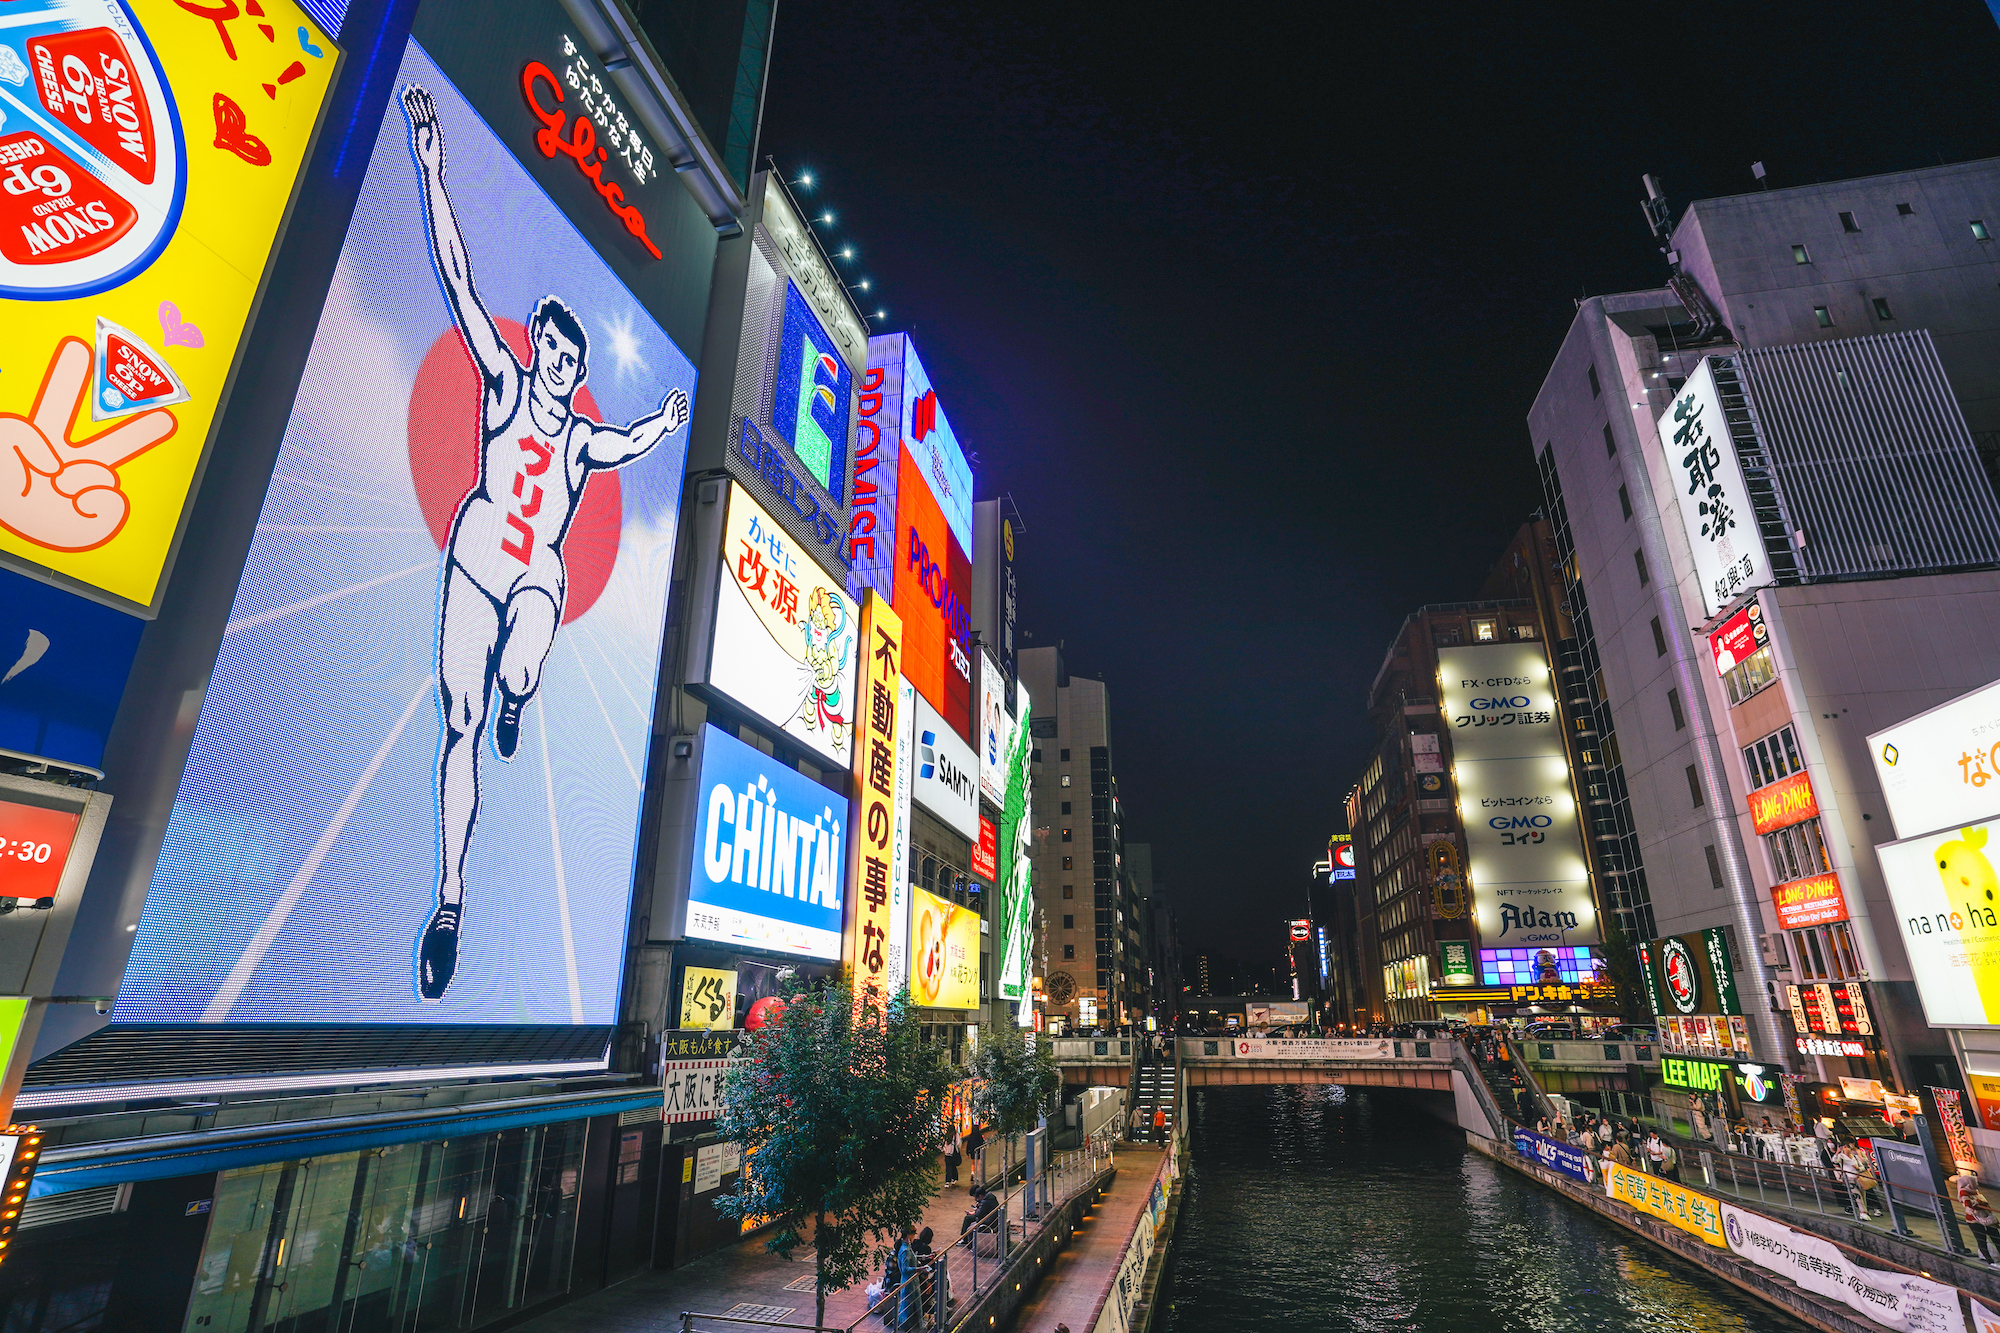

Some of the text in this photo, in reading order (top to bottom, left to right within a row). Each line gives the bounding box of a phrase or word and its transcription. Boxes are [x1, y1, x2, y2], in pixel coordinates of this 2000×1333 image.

[34, 44, 65, 114] CHEESE
[62, 54, 93, 125] 6P
[93, 76, 113, 123] BRAND
[99, 52, 148, 163] SNOW
[563, 34, 657, 178] すこやかな毎日、
[566, 65, 646, 185] ゆたかな人生
[2, 164, 72, 197] 6P
[522, 61, 663, 260] Glico
[32, 195, 76, 217] BRAND
[21, 200, 115, 256] SNOW
[108, 373, 137, 400] CHEESE
[114, 363, 145, 393] 6P
[117, 345, 166, 386] SNOW
[126, 362, 147, 382] BRAND
[850, 367, 884, 559] PROMISE
[501, 434, 555, 567] グリコ
[749, 516, 797, 579] かぜに
[737, 538, 800, 627] 改源
[909, 525, 972, 656] PROMISE
[1714, 553, 1753, 602] 紹興酒
[947, 638, 971, 684] プロミス
[1455, 711, 1551, 728] クリック証券
[1470, 696, 1531, 710] GMO
[939, 753, 975, 807] SAMTY
[1481, 796, 1553, 807] ビットコインなら
[1489, 815, 1552, 829] GMO
[1755, 782, 1812, 826] LONG DINH
[1500, 831, 1545, 846] コイン
[1778, 879, 1835, 906] LONG DINH
[1780, 898, 1839, 914] VIETNAM RESTAURANT
[1499, 902, 1579, 937] Adam
[1527, 933, 1559, 942] GMO
[1446, 945, 1467, 964] 薬
[693, 976, 726, 1022] くくる
[1788, 986, 1807, 1031] たこ焼き
[1848, 984, 1870, 1034] 串かつ
[668, 1037, 732, 1056] 大阪もんを食す
[1806, 1038, 1864, 1057] 香港飯店 0410
[1661, 1058, 1688, 1087] LEE
[1896, 1153, 1922, 1165] information
